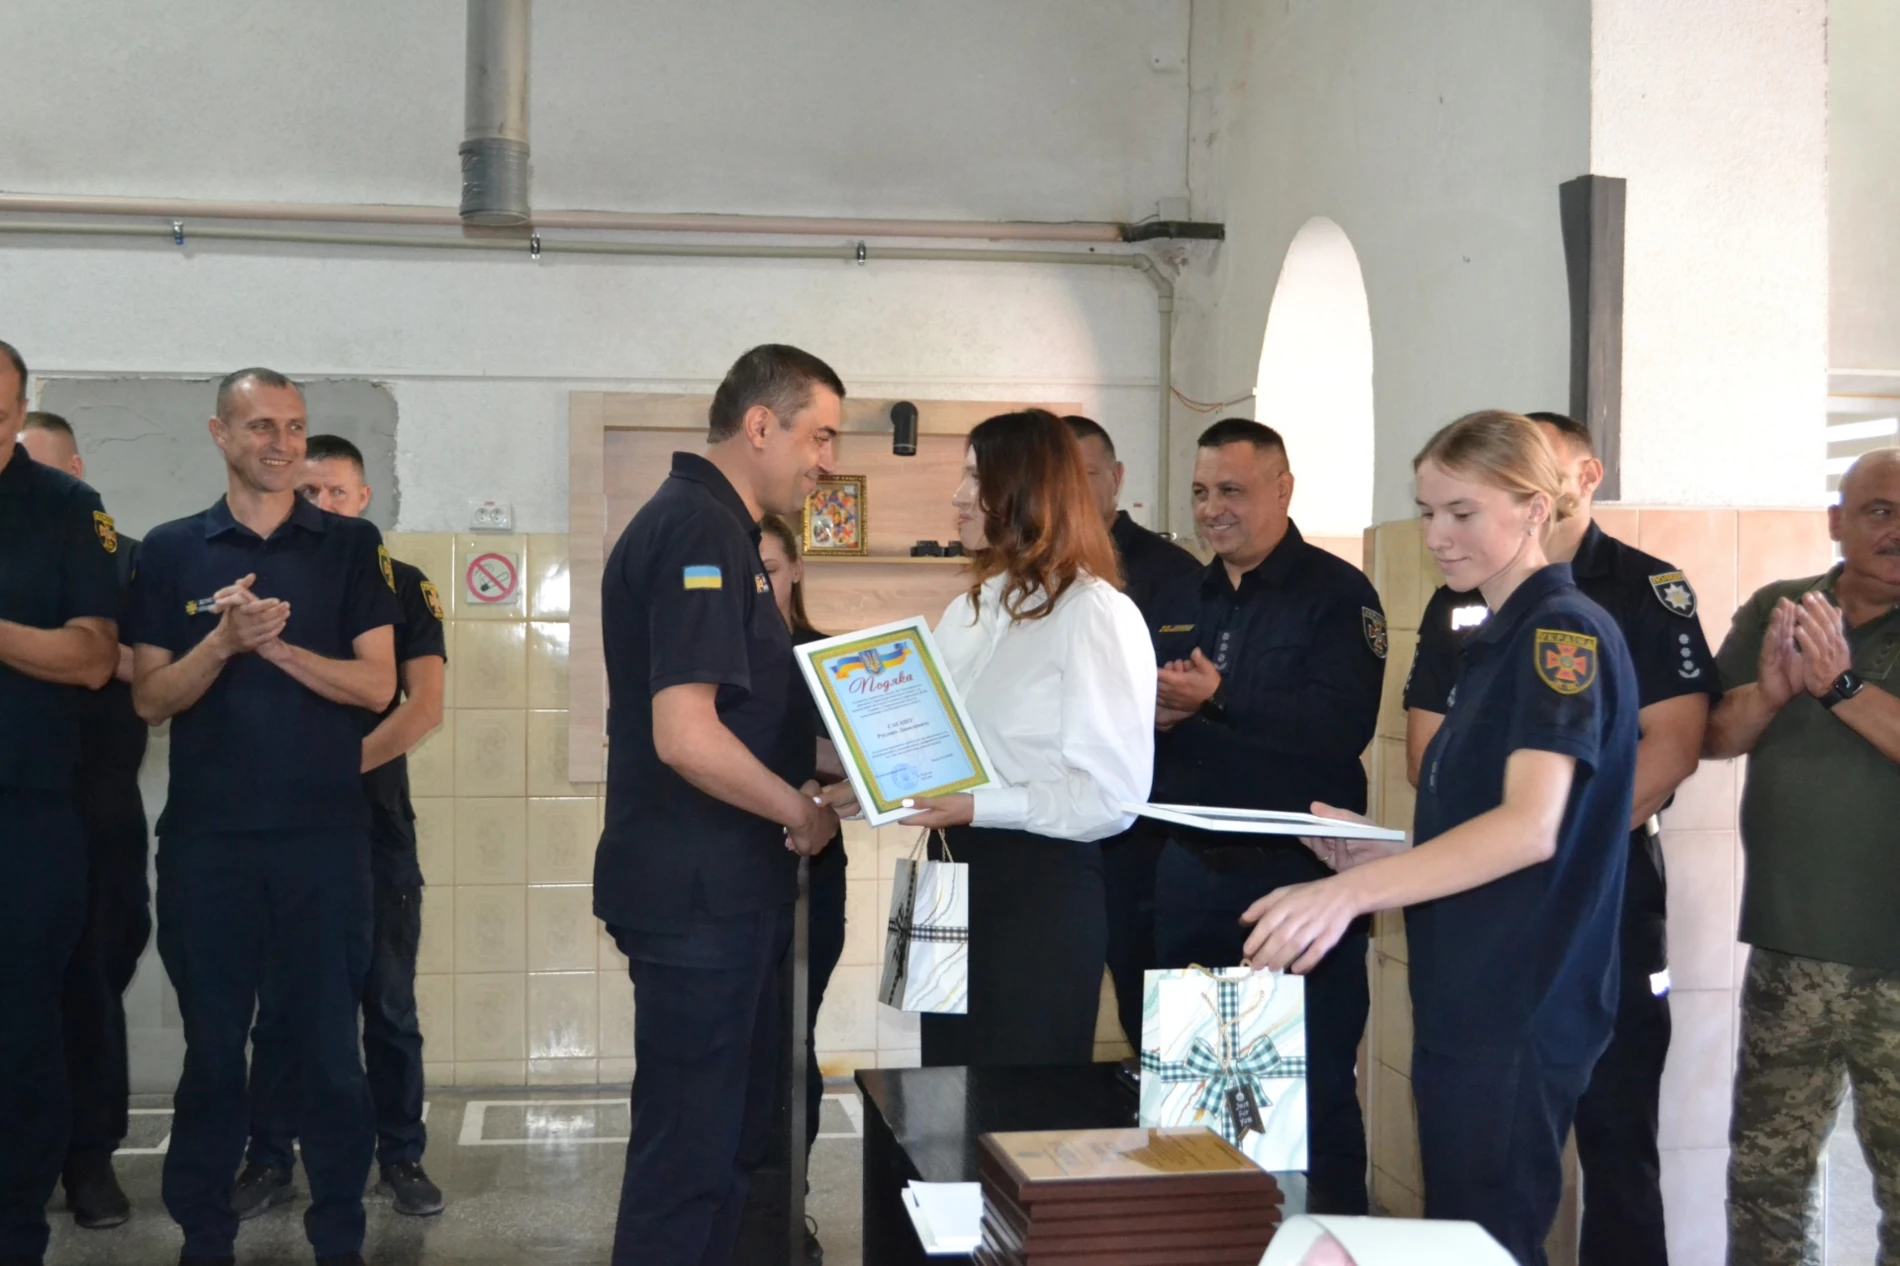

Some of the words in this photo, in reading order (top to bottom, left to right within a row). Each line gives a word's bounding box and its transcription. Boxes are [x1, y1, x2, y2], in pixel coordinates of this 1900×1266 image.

[849, 671, 913, 694] Подяка
[1239, 1109, 1248, 1117] For
[1240, 1117, 1252, 1127] You
